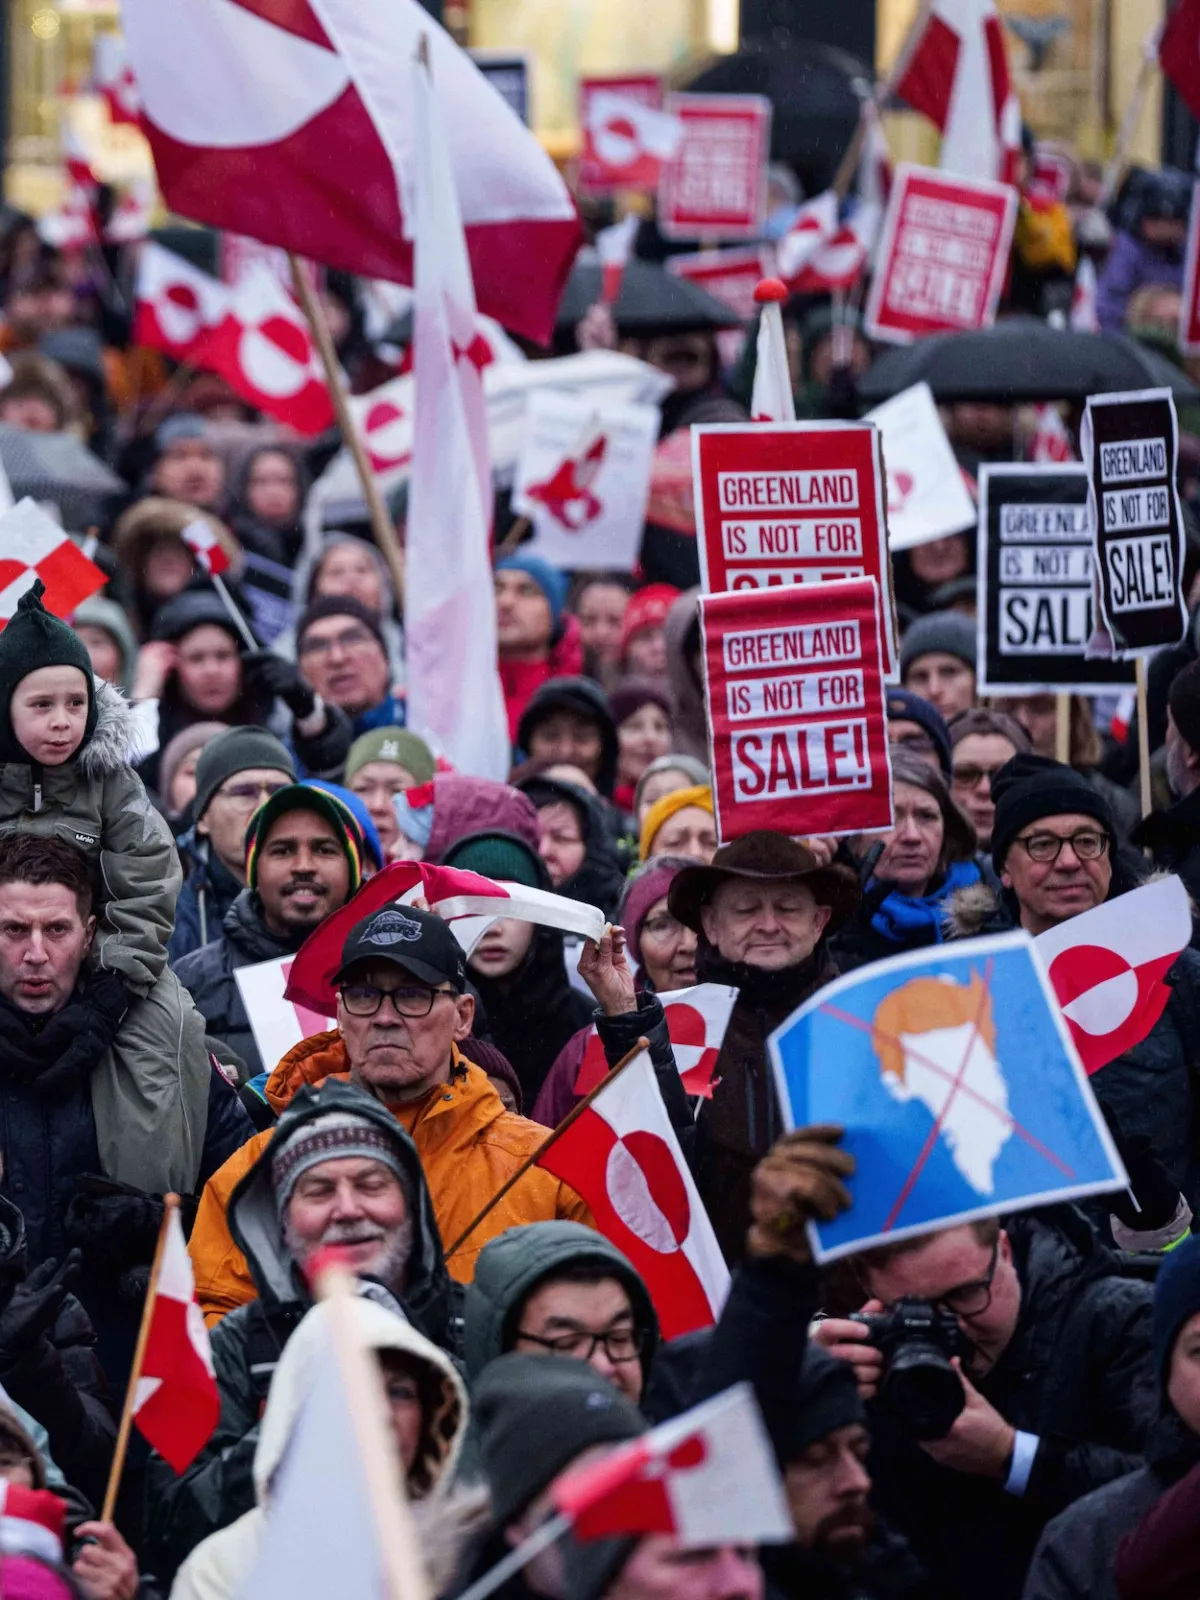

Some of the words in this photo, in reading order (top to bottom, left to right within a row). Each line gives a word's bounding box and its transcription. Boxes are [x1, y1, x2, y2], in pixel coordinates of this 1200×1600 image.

[1103, 443, 1166, 478] GREENLAND
[723, 474, 854, 506] GREENLAND
[1105, 499, 1116, 526] IS
[1121, 495, 1141, 524] NOT
[1147, 490, 1169, 520] FOR
[726, 526, 747, 554] IS
[758, 524, 801, 553] NOT
[814, 523, 857, 552] FOR
[1005, 552, 1022, 576] IS
[1033, 551, 1070, 575] NOT
[1109, 541, 1173, 607] SALE!
[727, 625, 856, 666] GREENLAND
[731, 685, 751, 715] IS
[763, 680, 805, 712] NOT
[818, 675, 859, 707] FOR
[735, 724, 867, 796] SALE!
